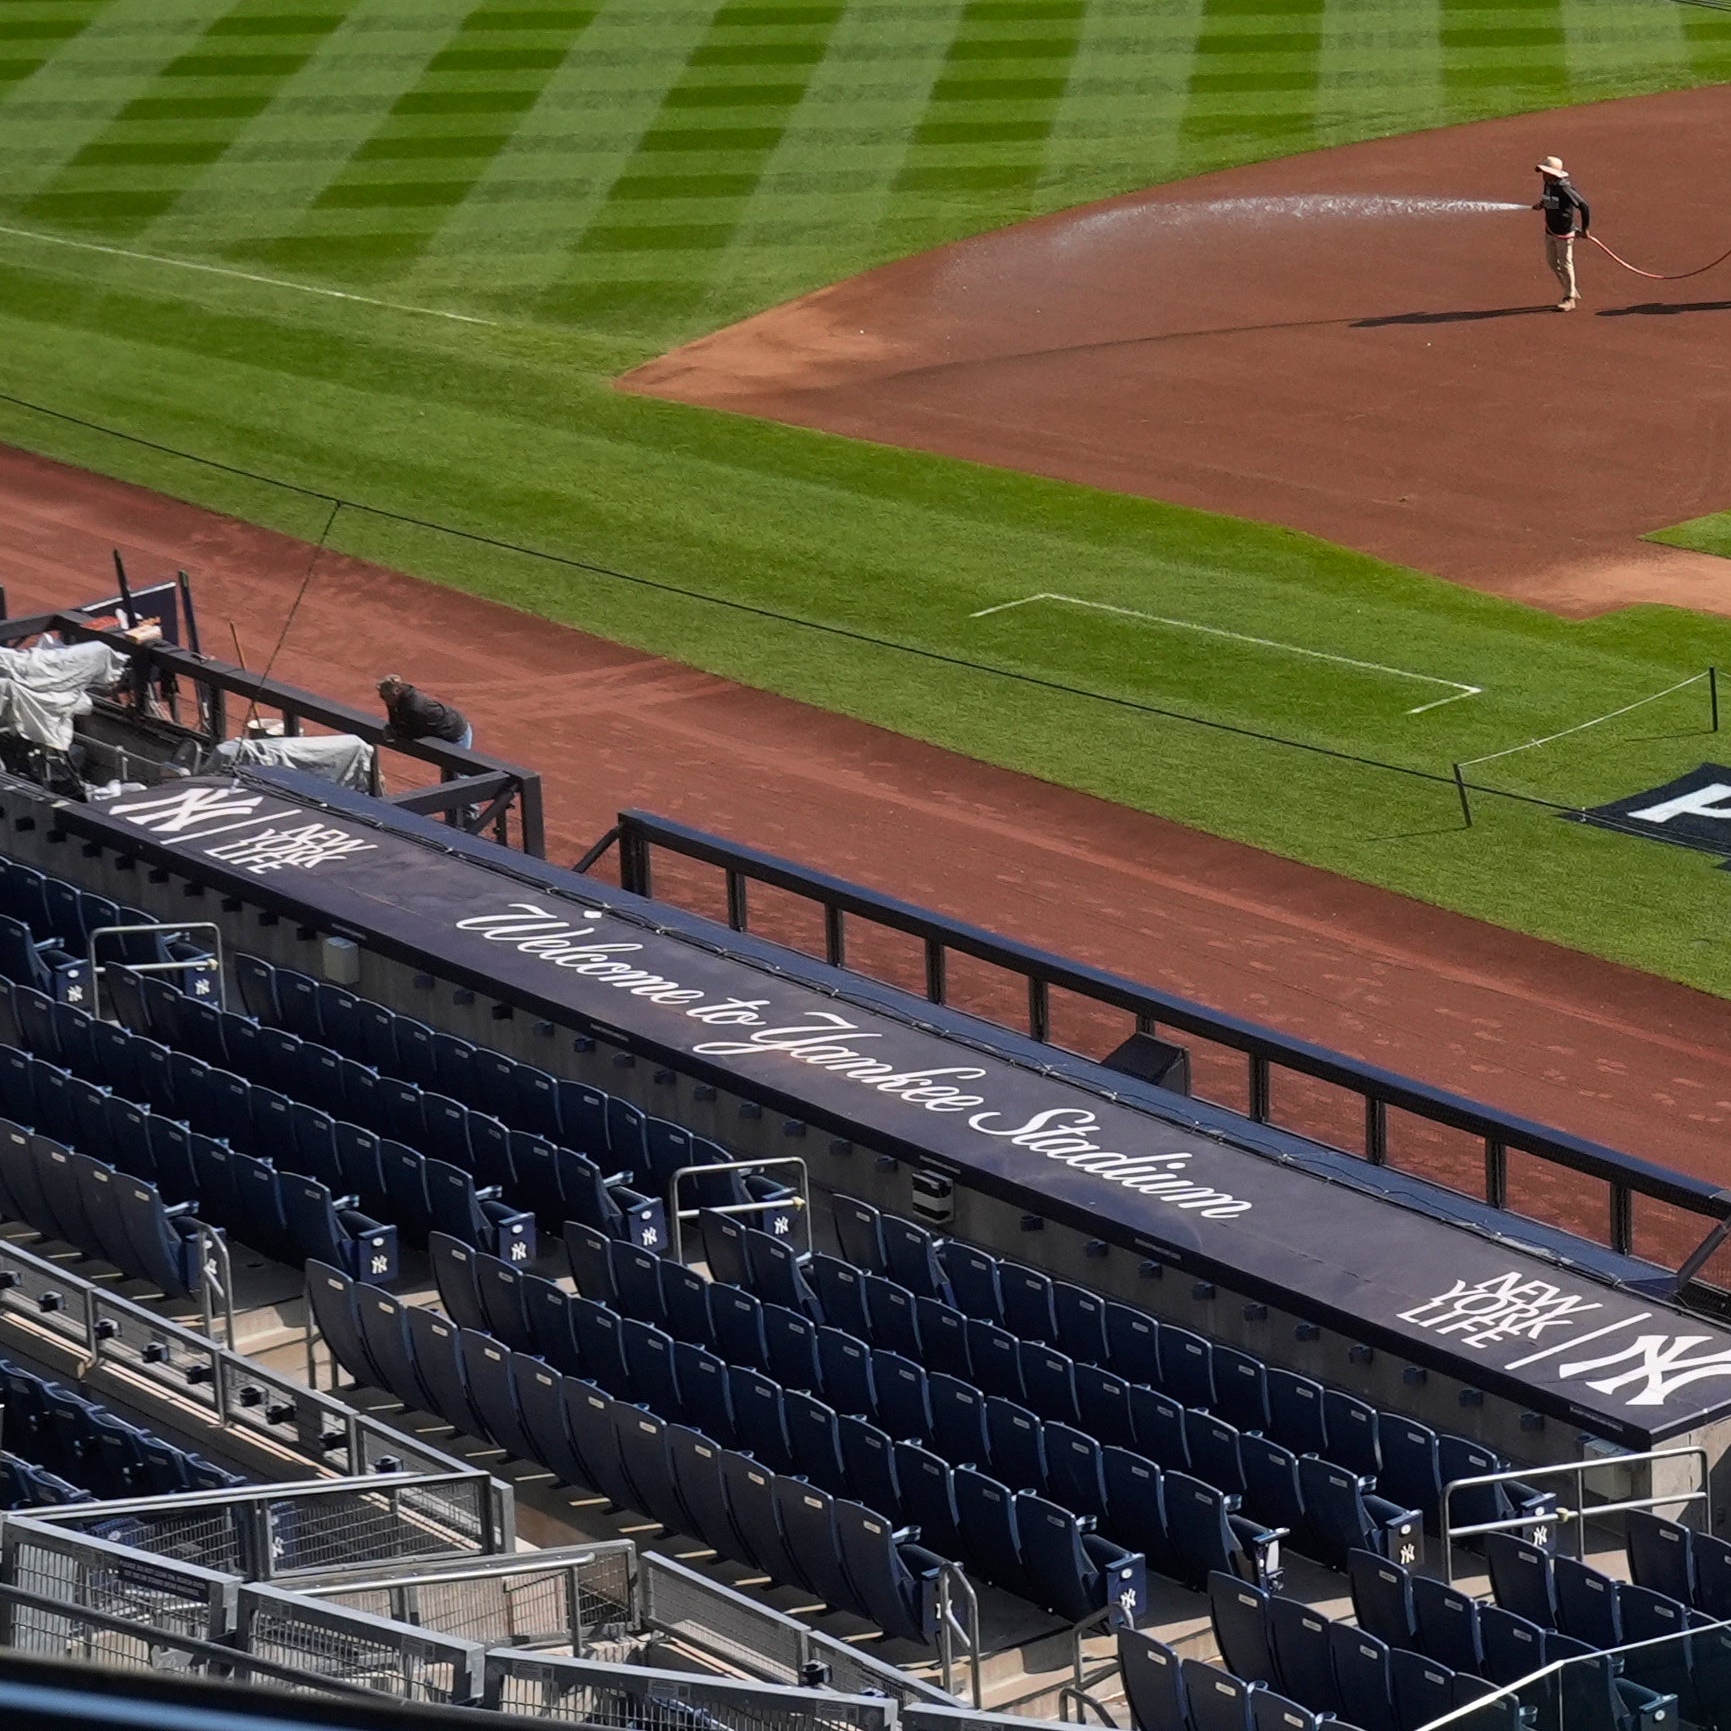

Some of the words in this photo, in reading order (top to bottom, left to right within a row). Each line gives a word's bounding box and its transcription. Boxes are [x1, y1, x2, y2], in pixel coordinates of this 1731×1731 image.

[203, 841, 282, 874] LIFE
[239, 829, 347, 868] YORK
[281, 823, 378, 853] NEW
[456, 903, 705, 1007] Welcome
[686, 997, 770, 1028] to
[693, 1011, 983, 1114] Yankee
[968, 1106, 1253, 1220] Stadium
[1430, 1279, 1573, 1339] YORK
[1473, 1271, 1603, 1318] NEW
[1395, 1302, 1505, 1349] LIFE
